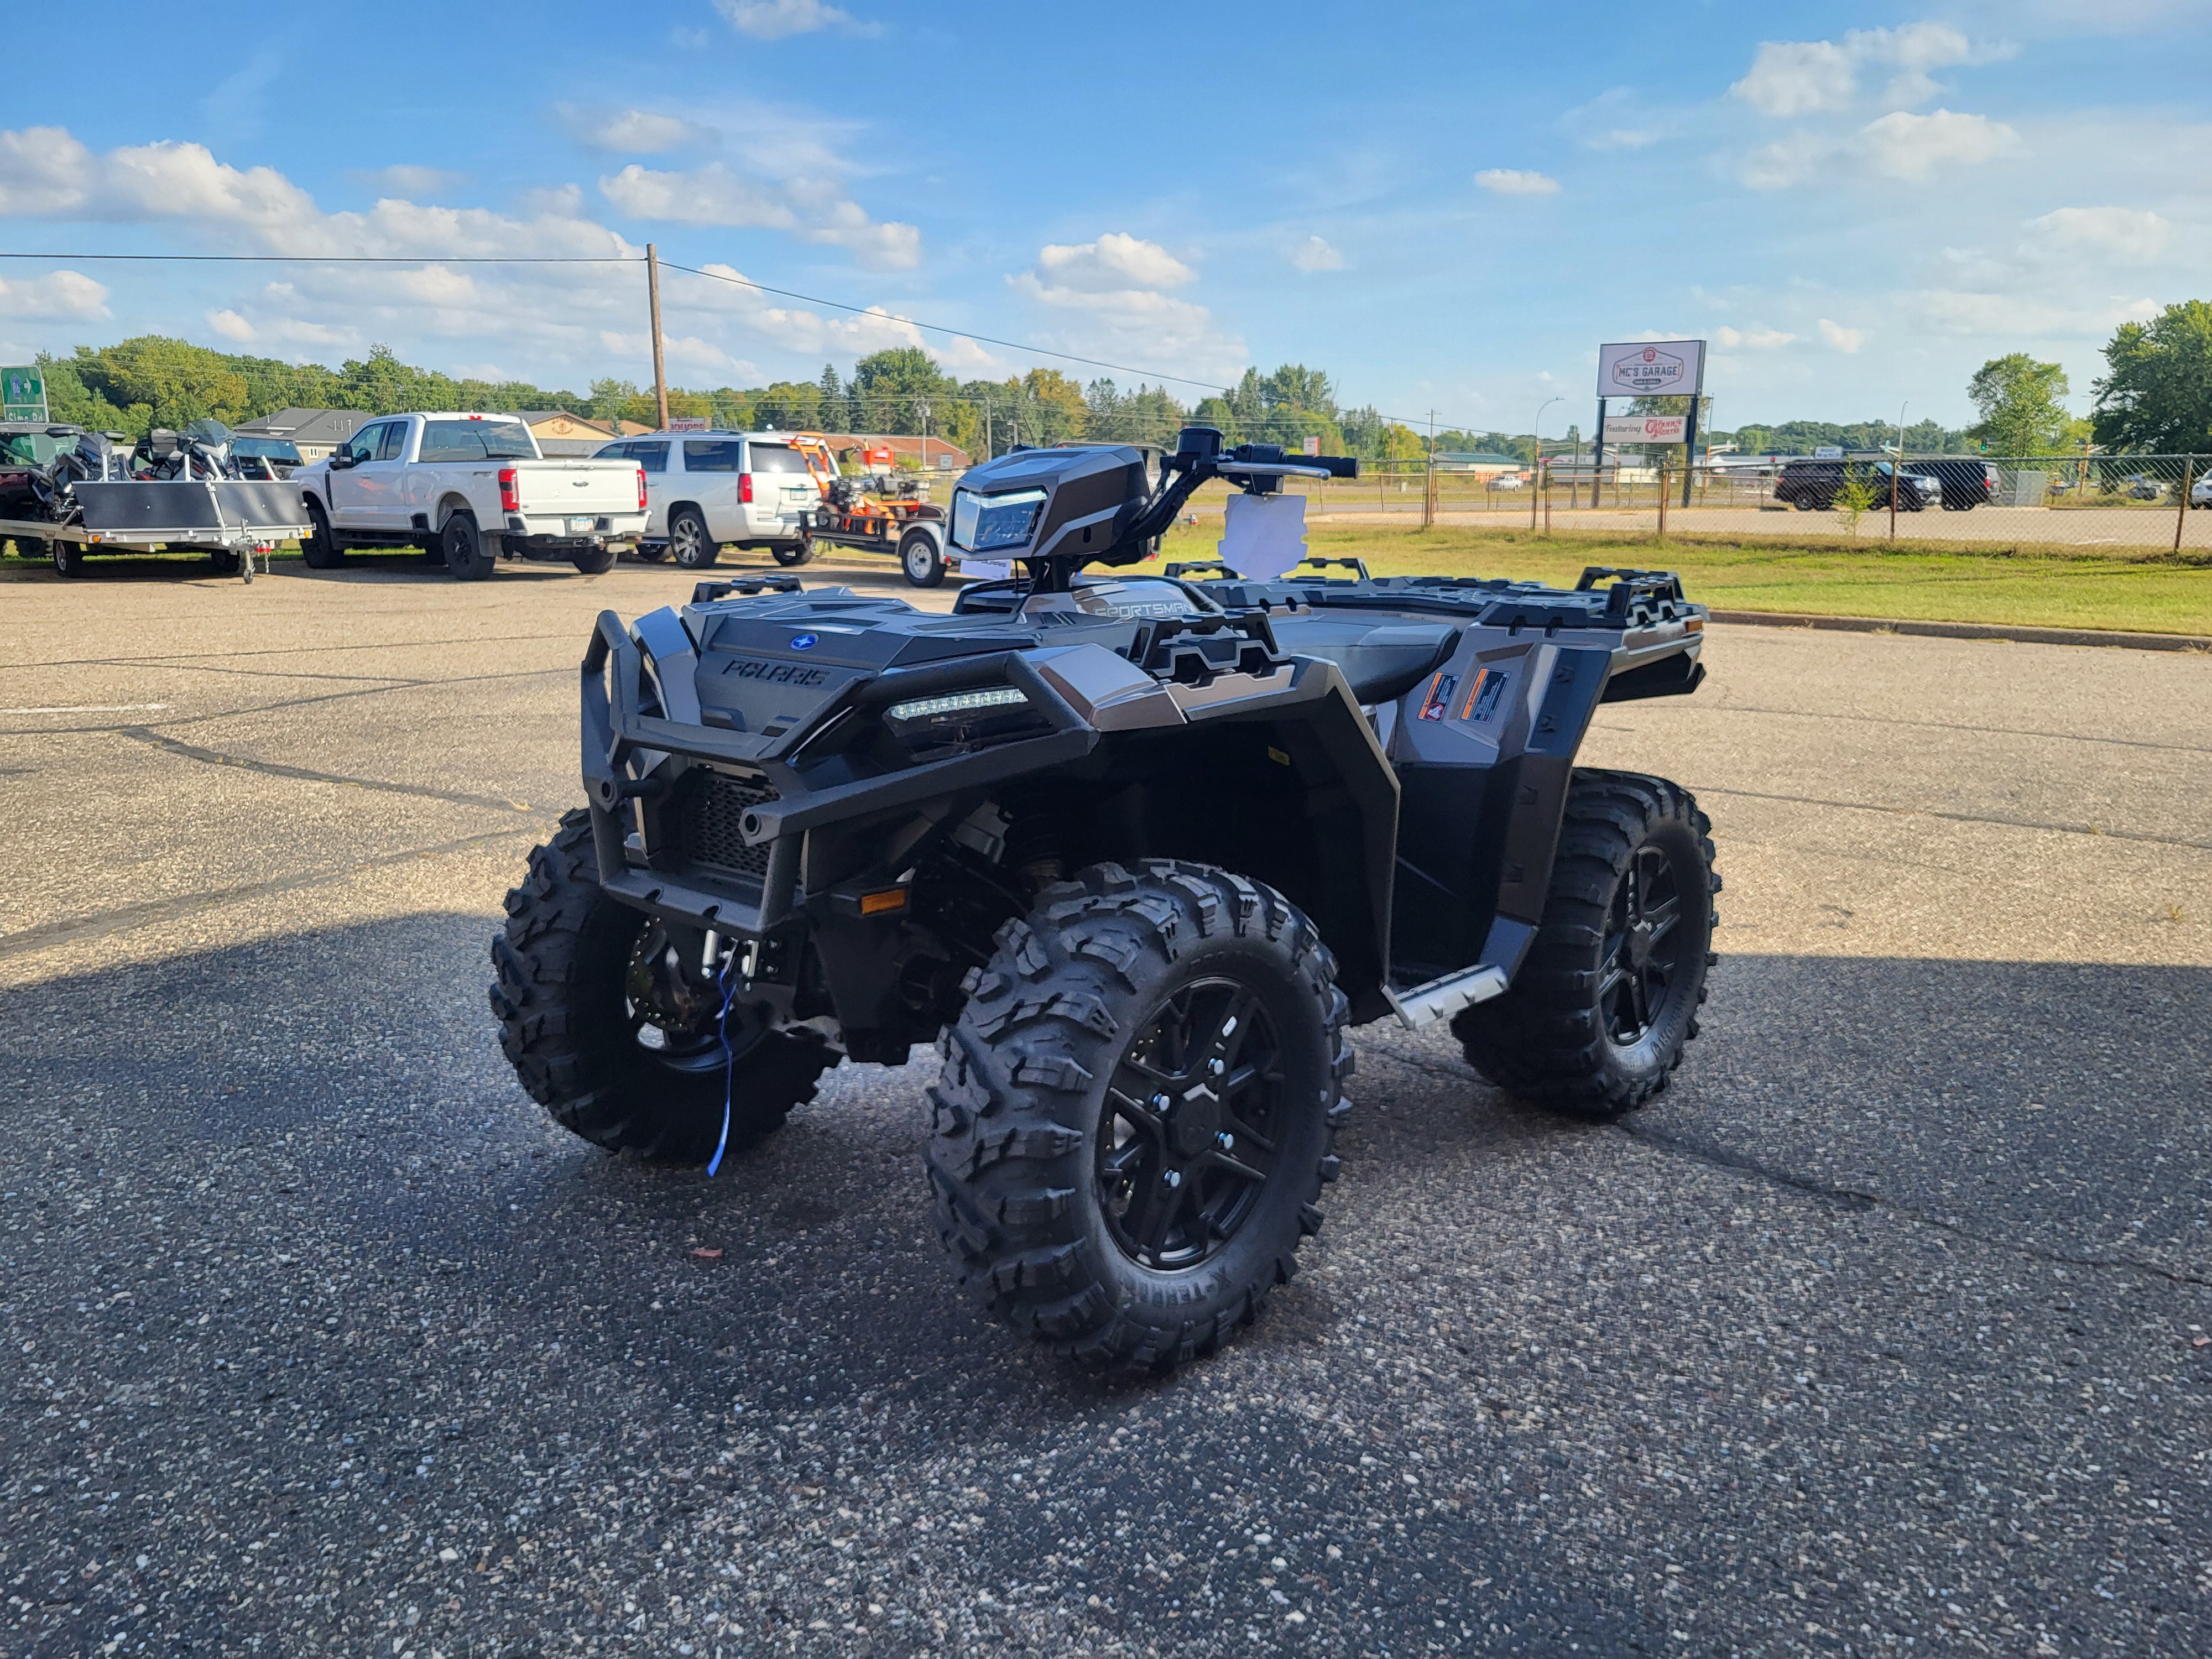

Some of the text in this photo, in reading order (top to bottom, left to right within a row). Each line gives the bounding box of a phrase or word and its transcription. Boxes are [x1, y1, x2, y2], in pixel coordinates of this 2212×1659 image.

[1619, 366, 1678, 377] MC'S GARAGE
[13, 382, 20, 393] 86
[1605, 424, 1641, 435] Featuring
[1094, 602, 1196, 617] SPORTSMAN
[722, 660, 830, 685] POLARIS
